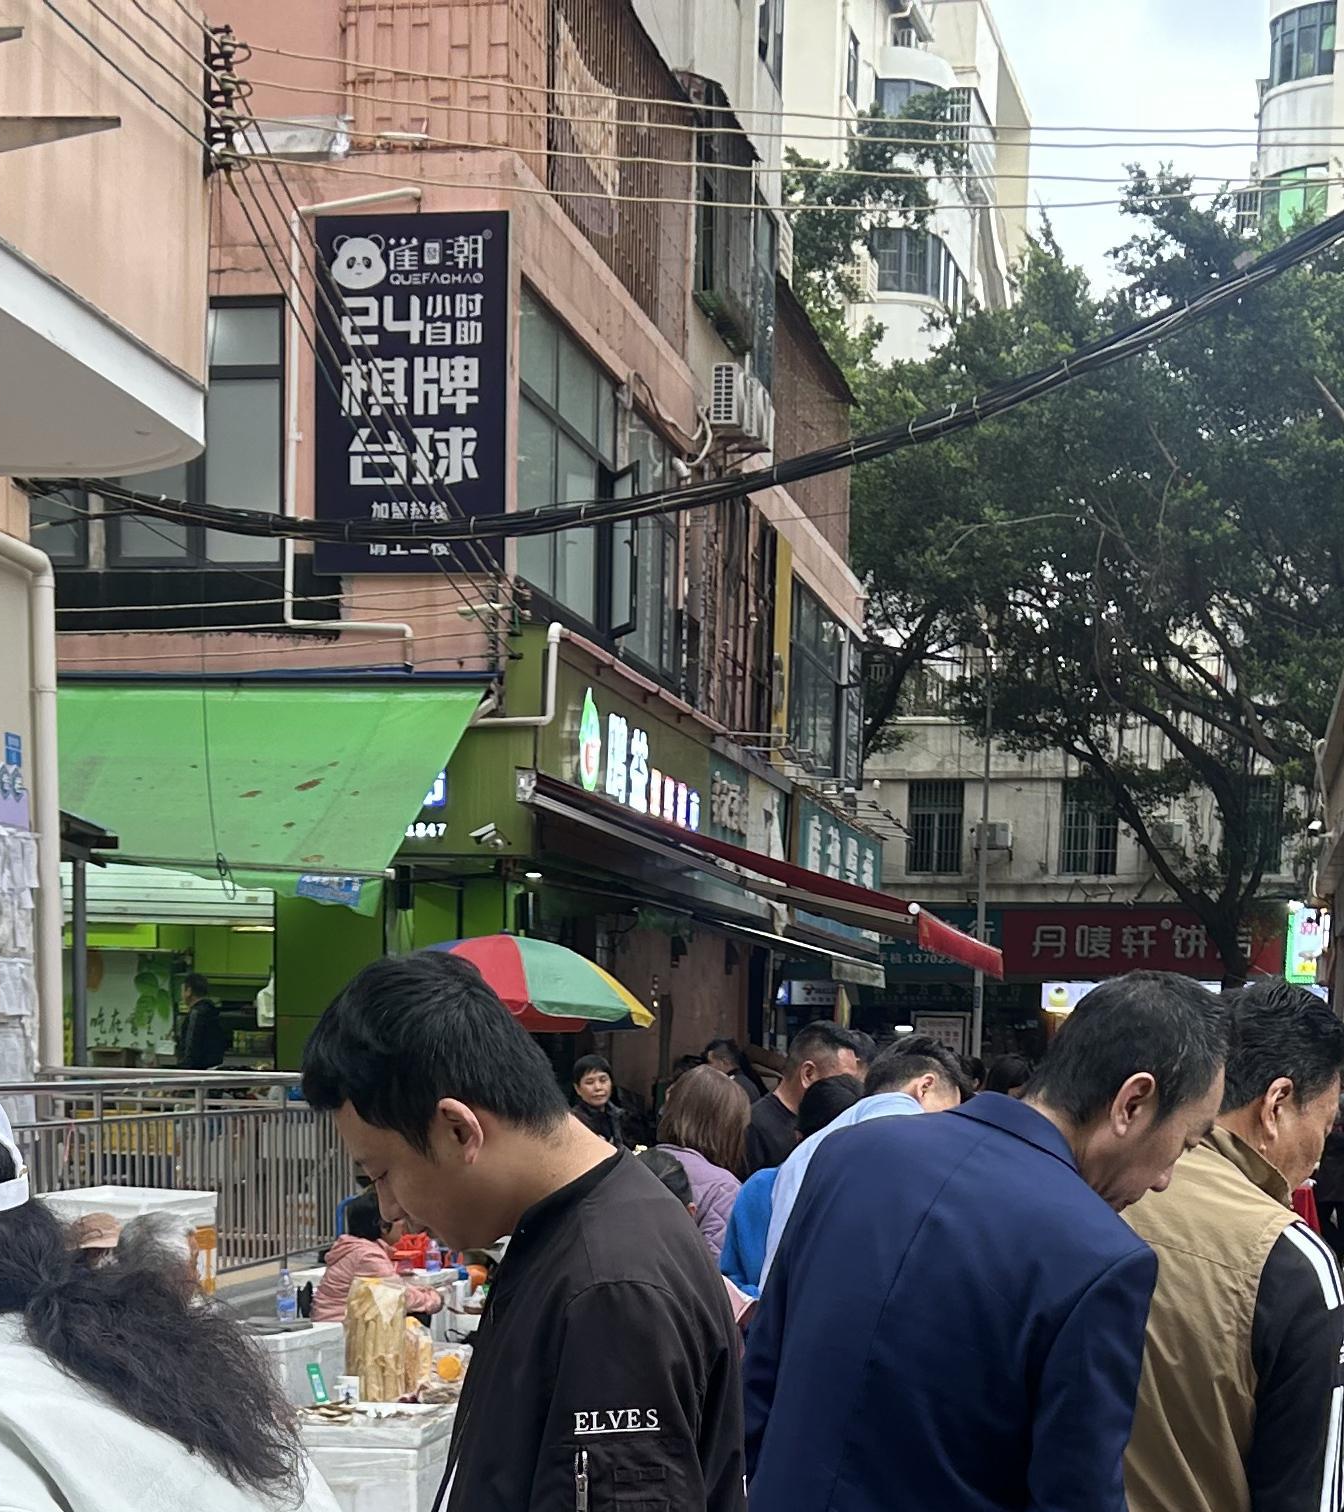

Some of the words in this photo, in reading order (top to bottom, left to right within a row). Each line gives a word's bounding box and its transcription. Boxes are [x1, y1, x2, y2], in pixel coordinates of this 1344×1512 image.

[341, 294, 425, 346] 24
[426, 293, 483, 318] 小时
[425, 321, 483, 346] 自助
[341, 356, 479, 418] 棋牌
[348, 427, 479, 486] 台球
[573, 1408, 659, 1432] ELVES
